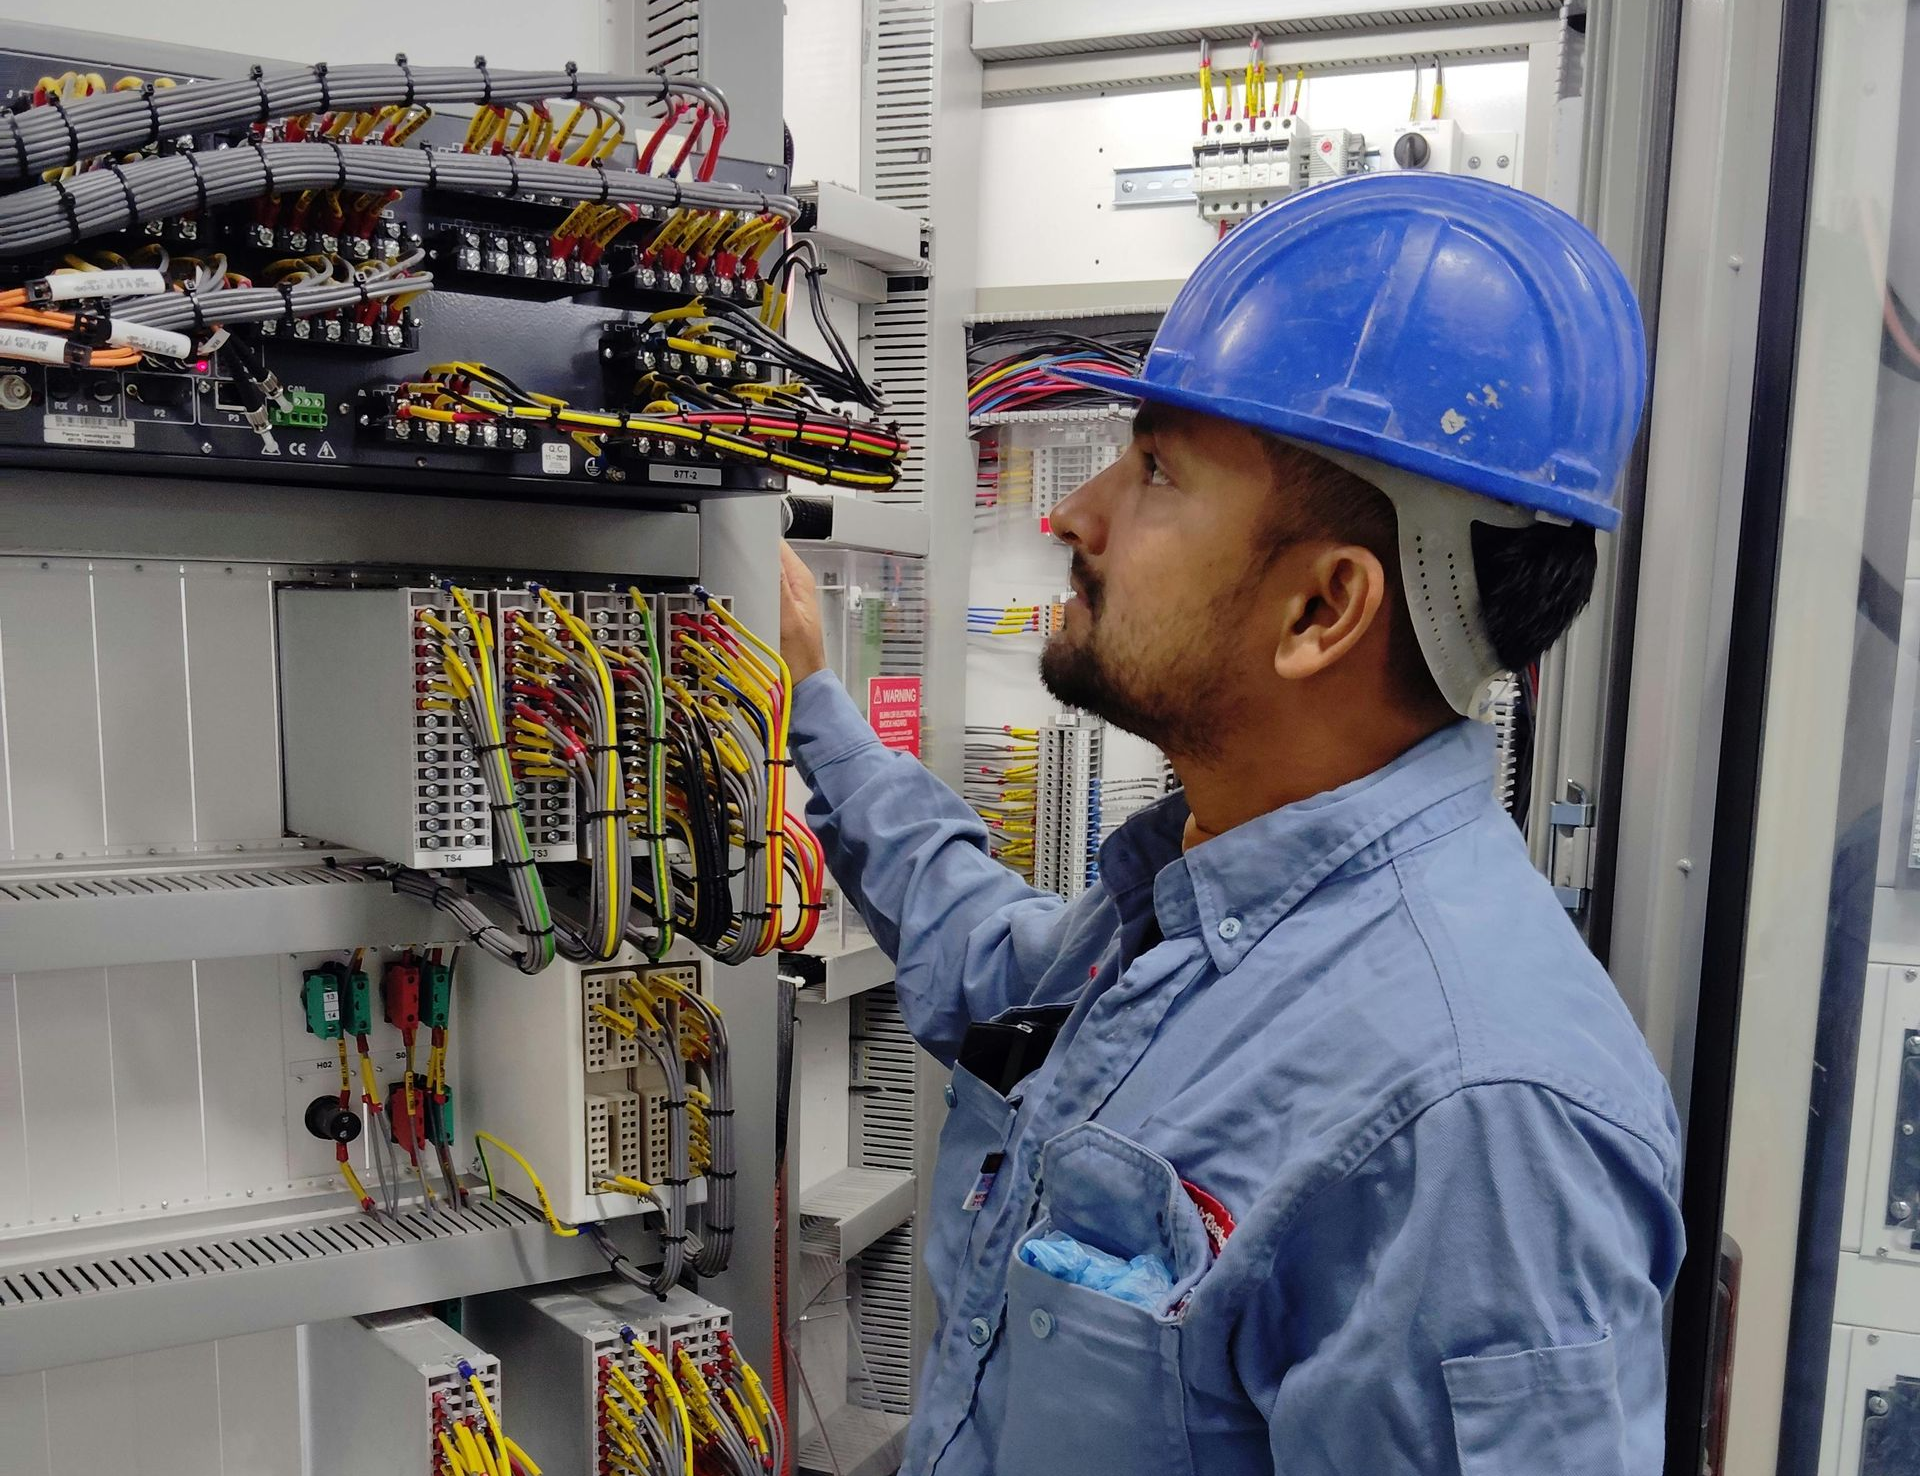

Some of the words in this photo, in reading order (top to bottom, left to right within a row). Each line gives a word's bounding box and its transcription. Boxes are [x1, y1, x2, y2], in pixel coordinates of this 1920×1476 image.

[54, 402, 69, 411] RX
[77, 404, 89, 413] P1
[100, 405, 113, 414] TX
[153, 409, 166, 418] P2
[228, 413, 240, 423] P3
[673, 469, 698, 480] 87T-2
[882, 688, 917, 703] WARNING
[532, 849, 548, 858] TS3
[444, 854, 462, 863] TS4
[316, 1060, 333, 1069] H02
